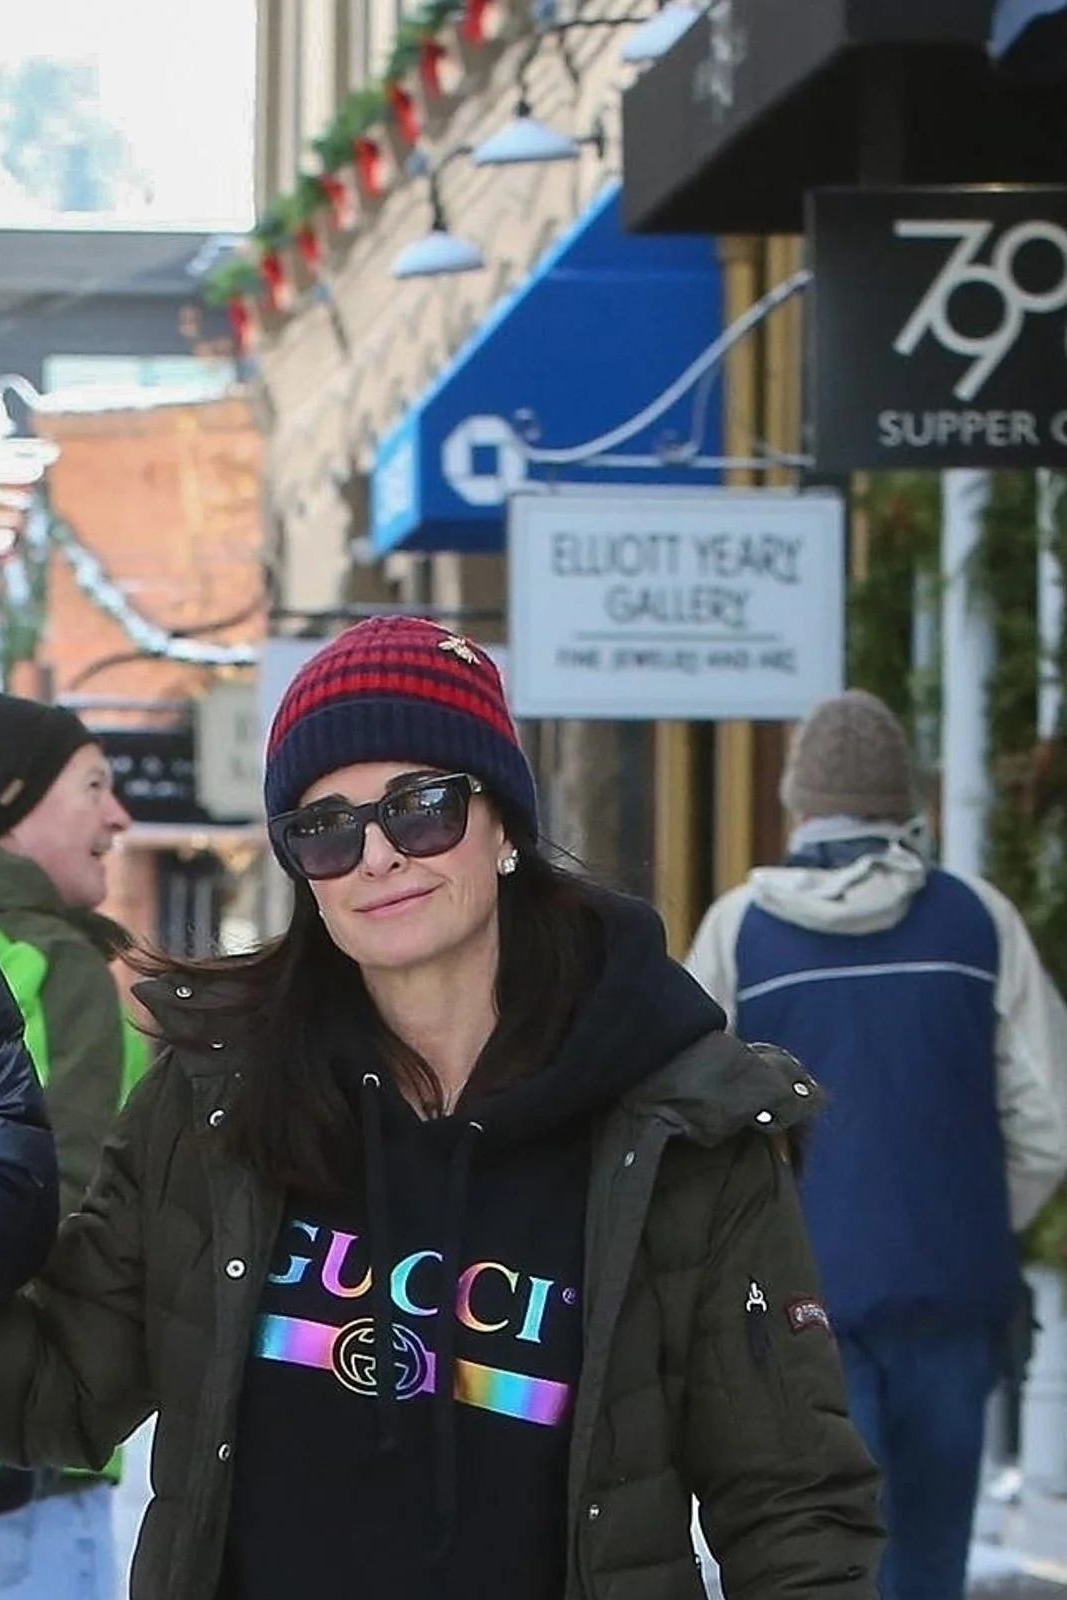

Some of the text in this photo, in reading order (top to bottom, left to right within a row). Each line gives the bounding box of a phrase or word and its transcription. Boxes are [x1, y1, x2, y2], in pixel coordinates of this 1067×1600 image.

[877, 408, 1039, 447] SUPPER
[550, 531, 807, 585] ELLIOTT YEARY
[603, 583, 751, 629] GALLERY
